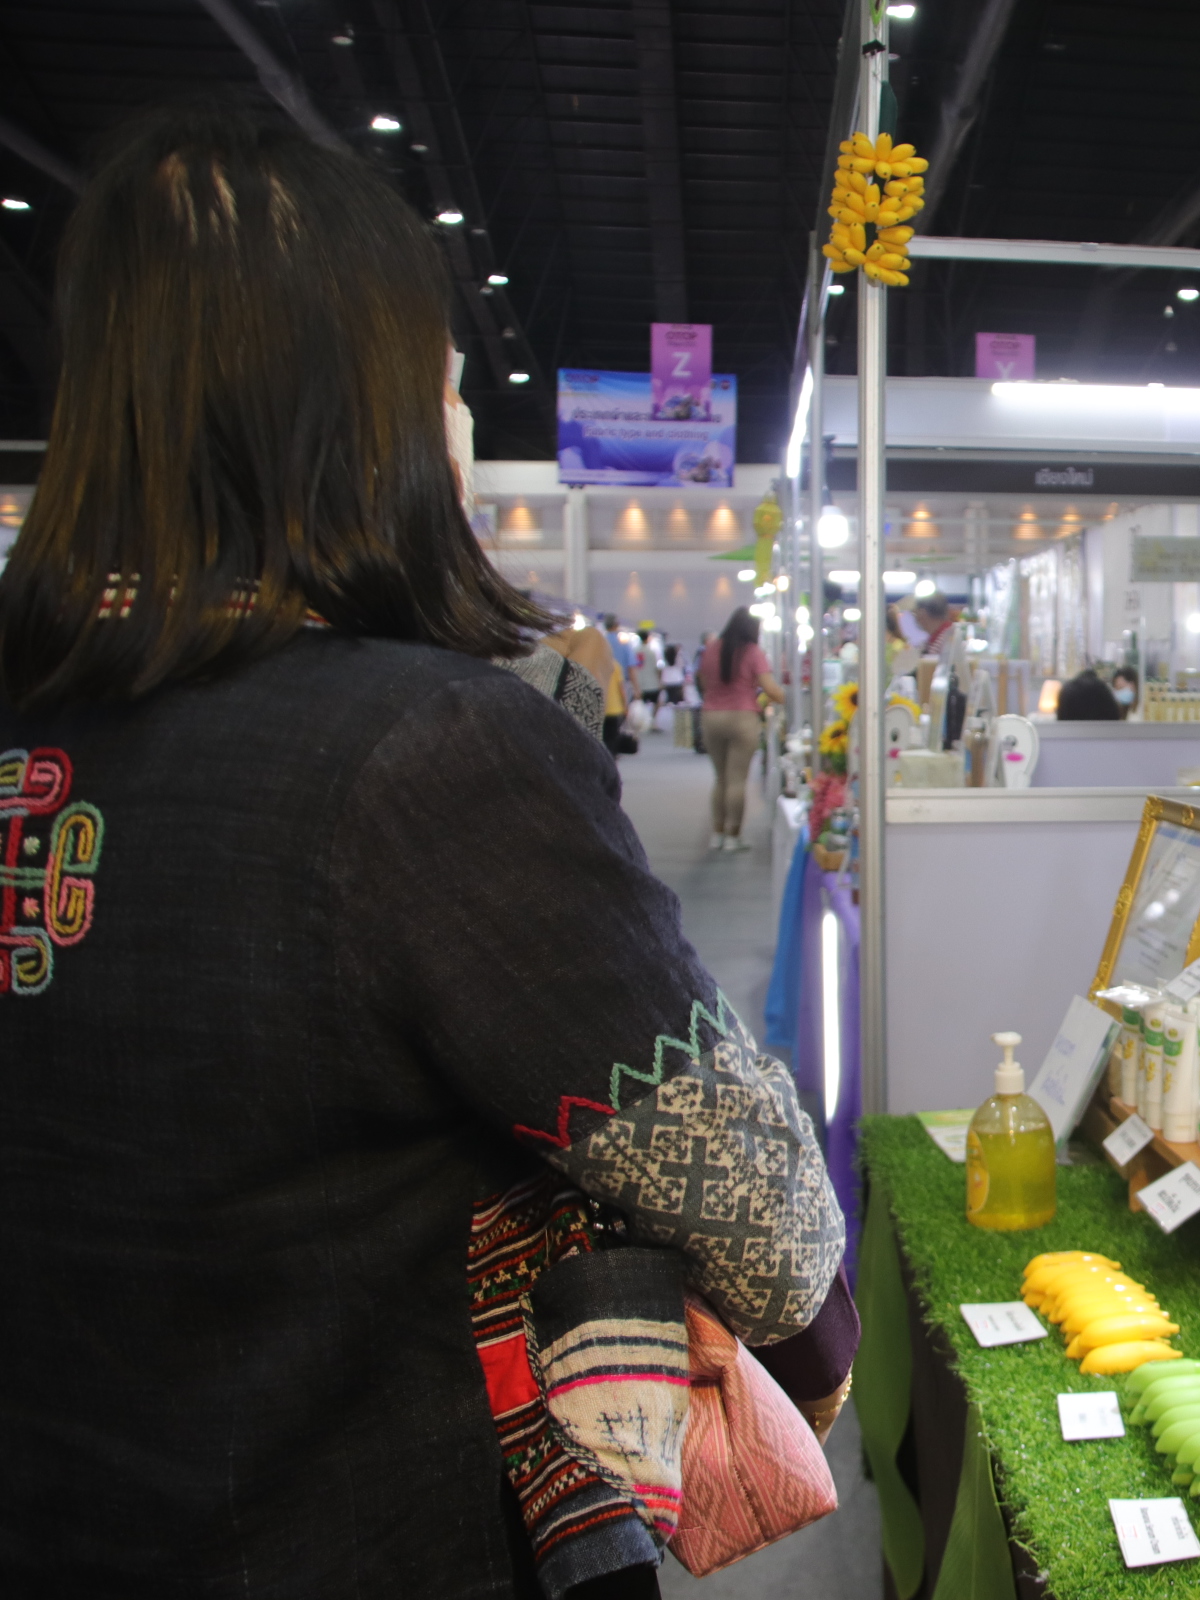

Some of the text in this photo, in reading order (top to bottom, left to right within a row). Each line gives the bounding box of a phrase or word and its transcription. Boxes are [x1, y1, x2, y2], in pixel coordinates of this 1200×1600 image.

[671, 351, 692, 377] Z
[645, 428, 665, 439] and
[1034, 466, 1094, 486] เชียงใหม่
